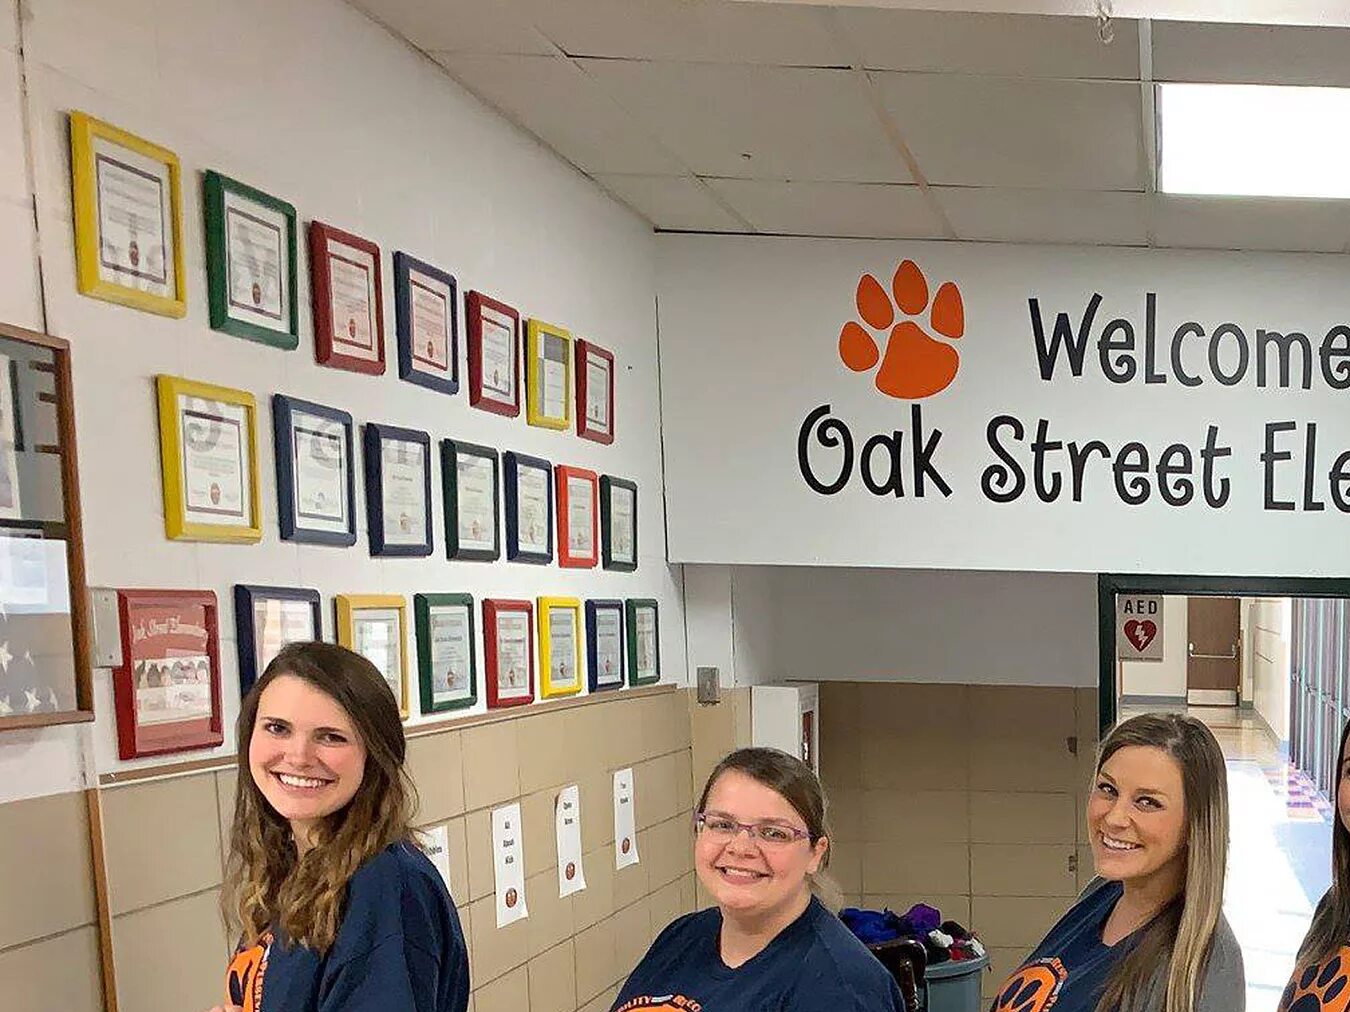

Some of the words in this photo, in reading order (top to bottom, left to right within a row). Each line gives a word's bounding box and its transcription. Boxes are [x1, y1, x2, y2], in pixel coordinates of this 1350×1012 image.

[798, 403, 953, 499] Oak
[980, 415, 1232, 510] Street
[1124, 599, 1158, 615] AED
